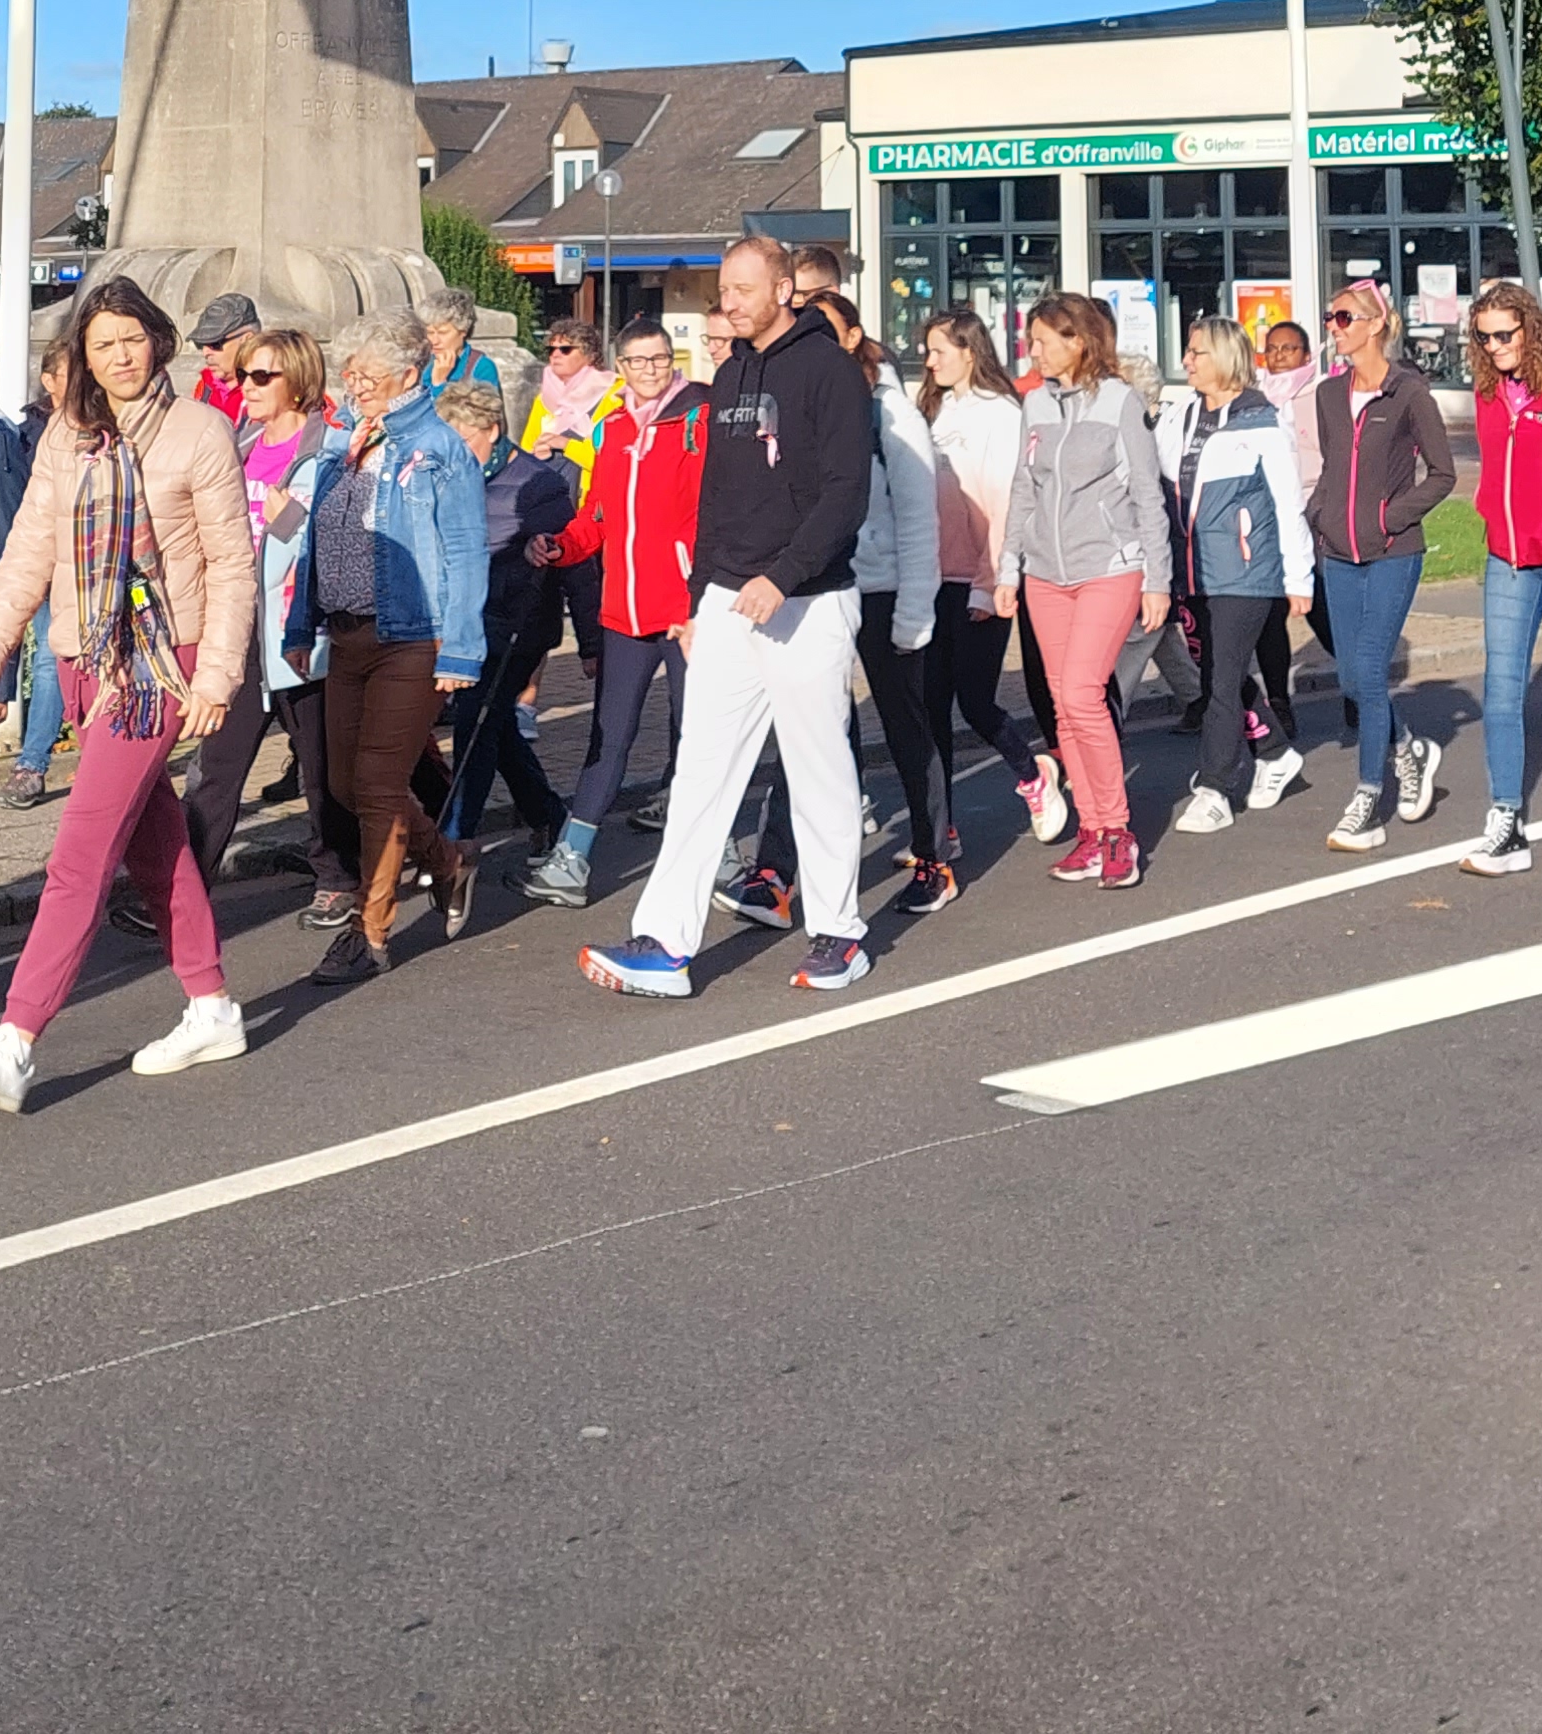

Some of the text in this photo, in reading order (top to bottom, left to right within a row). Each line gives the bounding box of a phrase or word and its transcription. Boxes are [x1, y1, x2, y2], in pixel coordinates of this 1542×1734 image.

[274, 30, 400, 58] OFFRANVILLE
[301, 97, 379, 121] BRAVES
[1315, 128, 1417, 155] Matériel
[877, 141, 1164, 170] PHARMACIE d'Offranville
